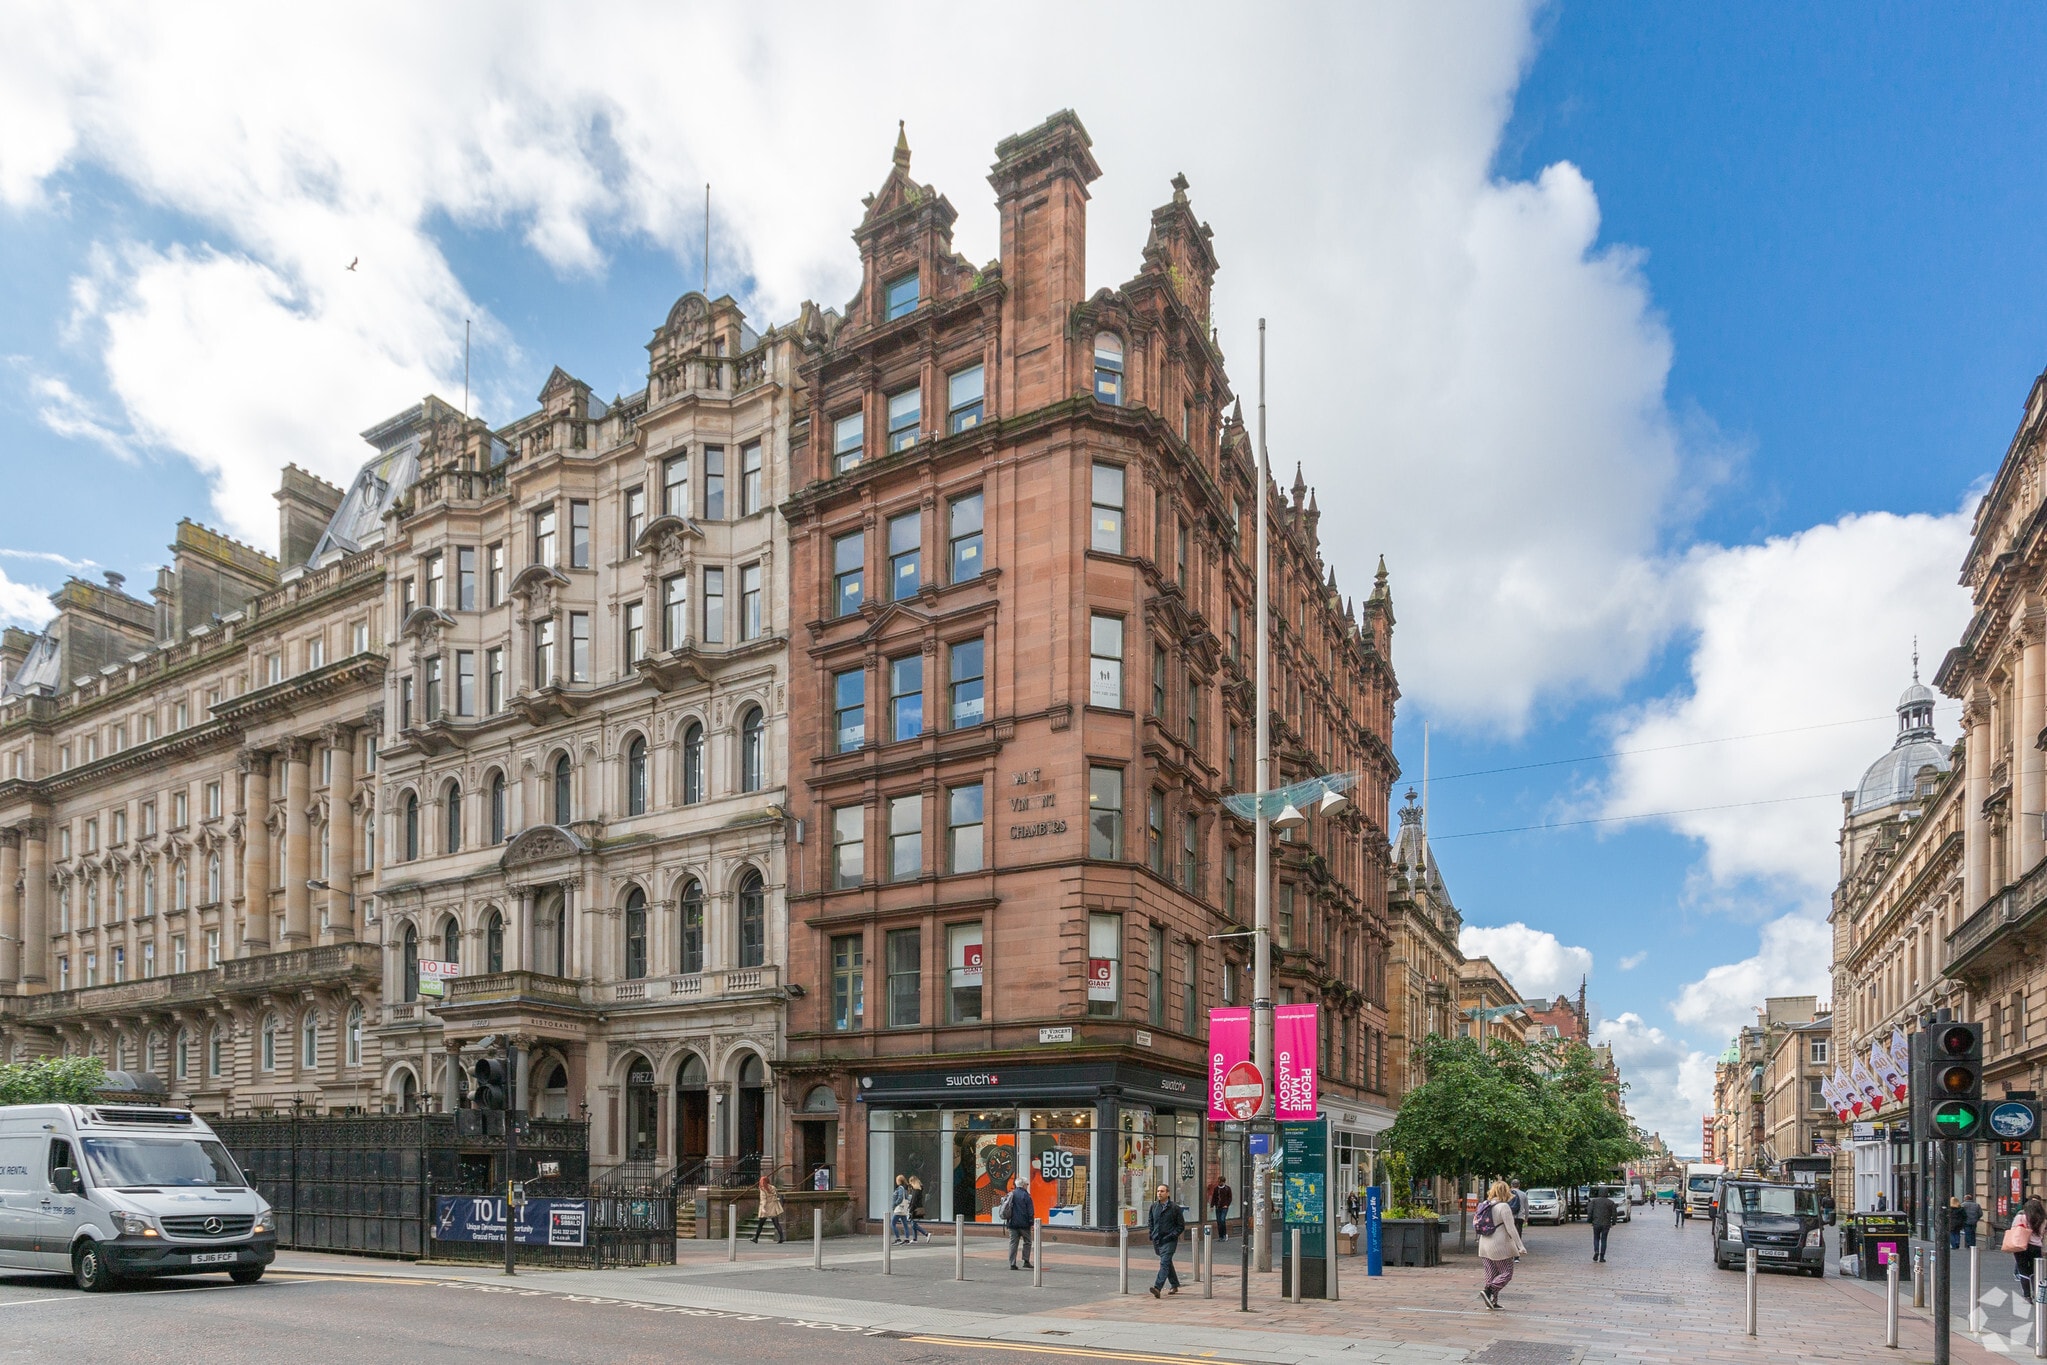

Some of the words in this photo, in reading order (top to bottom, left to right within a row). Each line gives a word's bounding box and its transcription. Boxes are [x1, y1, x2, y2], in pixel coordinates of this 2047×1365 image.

[1010, 794, 1055, 811] VINNT
[1010, 820, 1066, 839] CHAMBRS
[421, 961, 437, 972] TO
[443, 964, 458, 974] LE
[531, 1019, 578, 1030] RISTORANTE
[1874, 1058, 1887, 1069] 40
[632, 1072, 654, 1082] PREZZ
[946, 1074, 990, 1086] swatch
[1213, 1053, 1224, 1111] GLASGOW
[1280, 1051, 1290, 1111] GLASGOW
[1855, 1072, 1866, 1081] 40
[1161, 1078, 1182, 1091] swatch
[1301, 1068, 1312, 1111] PEOPLE
[1291, 1077, 1300, 1111] MAKE
[2002, 1141, 2022, 1152] T2
[1043, 1151, 1074, 1168] BIG
[1182, 1153, 1194, 1168] BIG
[7, 1166, 27, 1175] RENTAL
[1042, 1168, 1074, 1178] BOLD
[1182, 1167, 1195, 1178] BOLD
[473, 1199, 493, 1221] TO
[496, 1200, 528, 1222] LT
[466, 1223, 480, 1231] Unique
[481, 1224, 507, 1232] Developmen
[218, 1253, 232, 1261] FCF
[778, 1319, 887, 1337] LOOK
